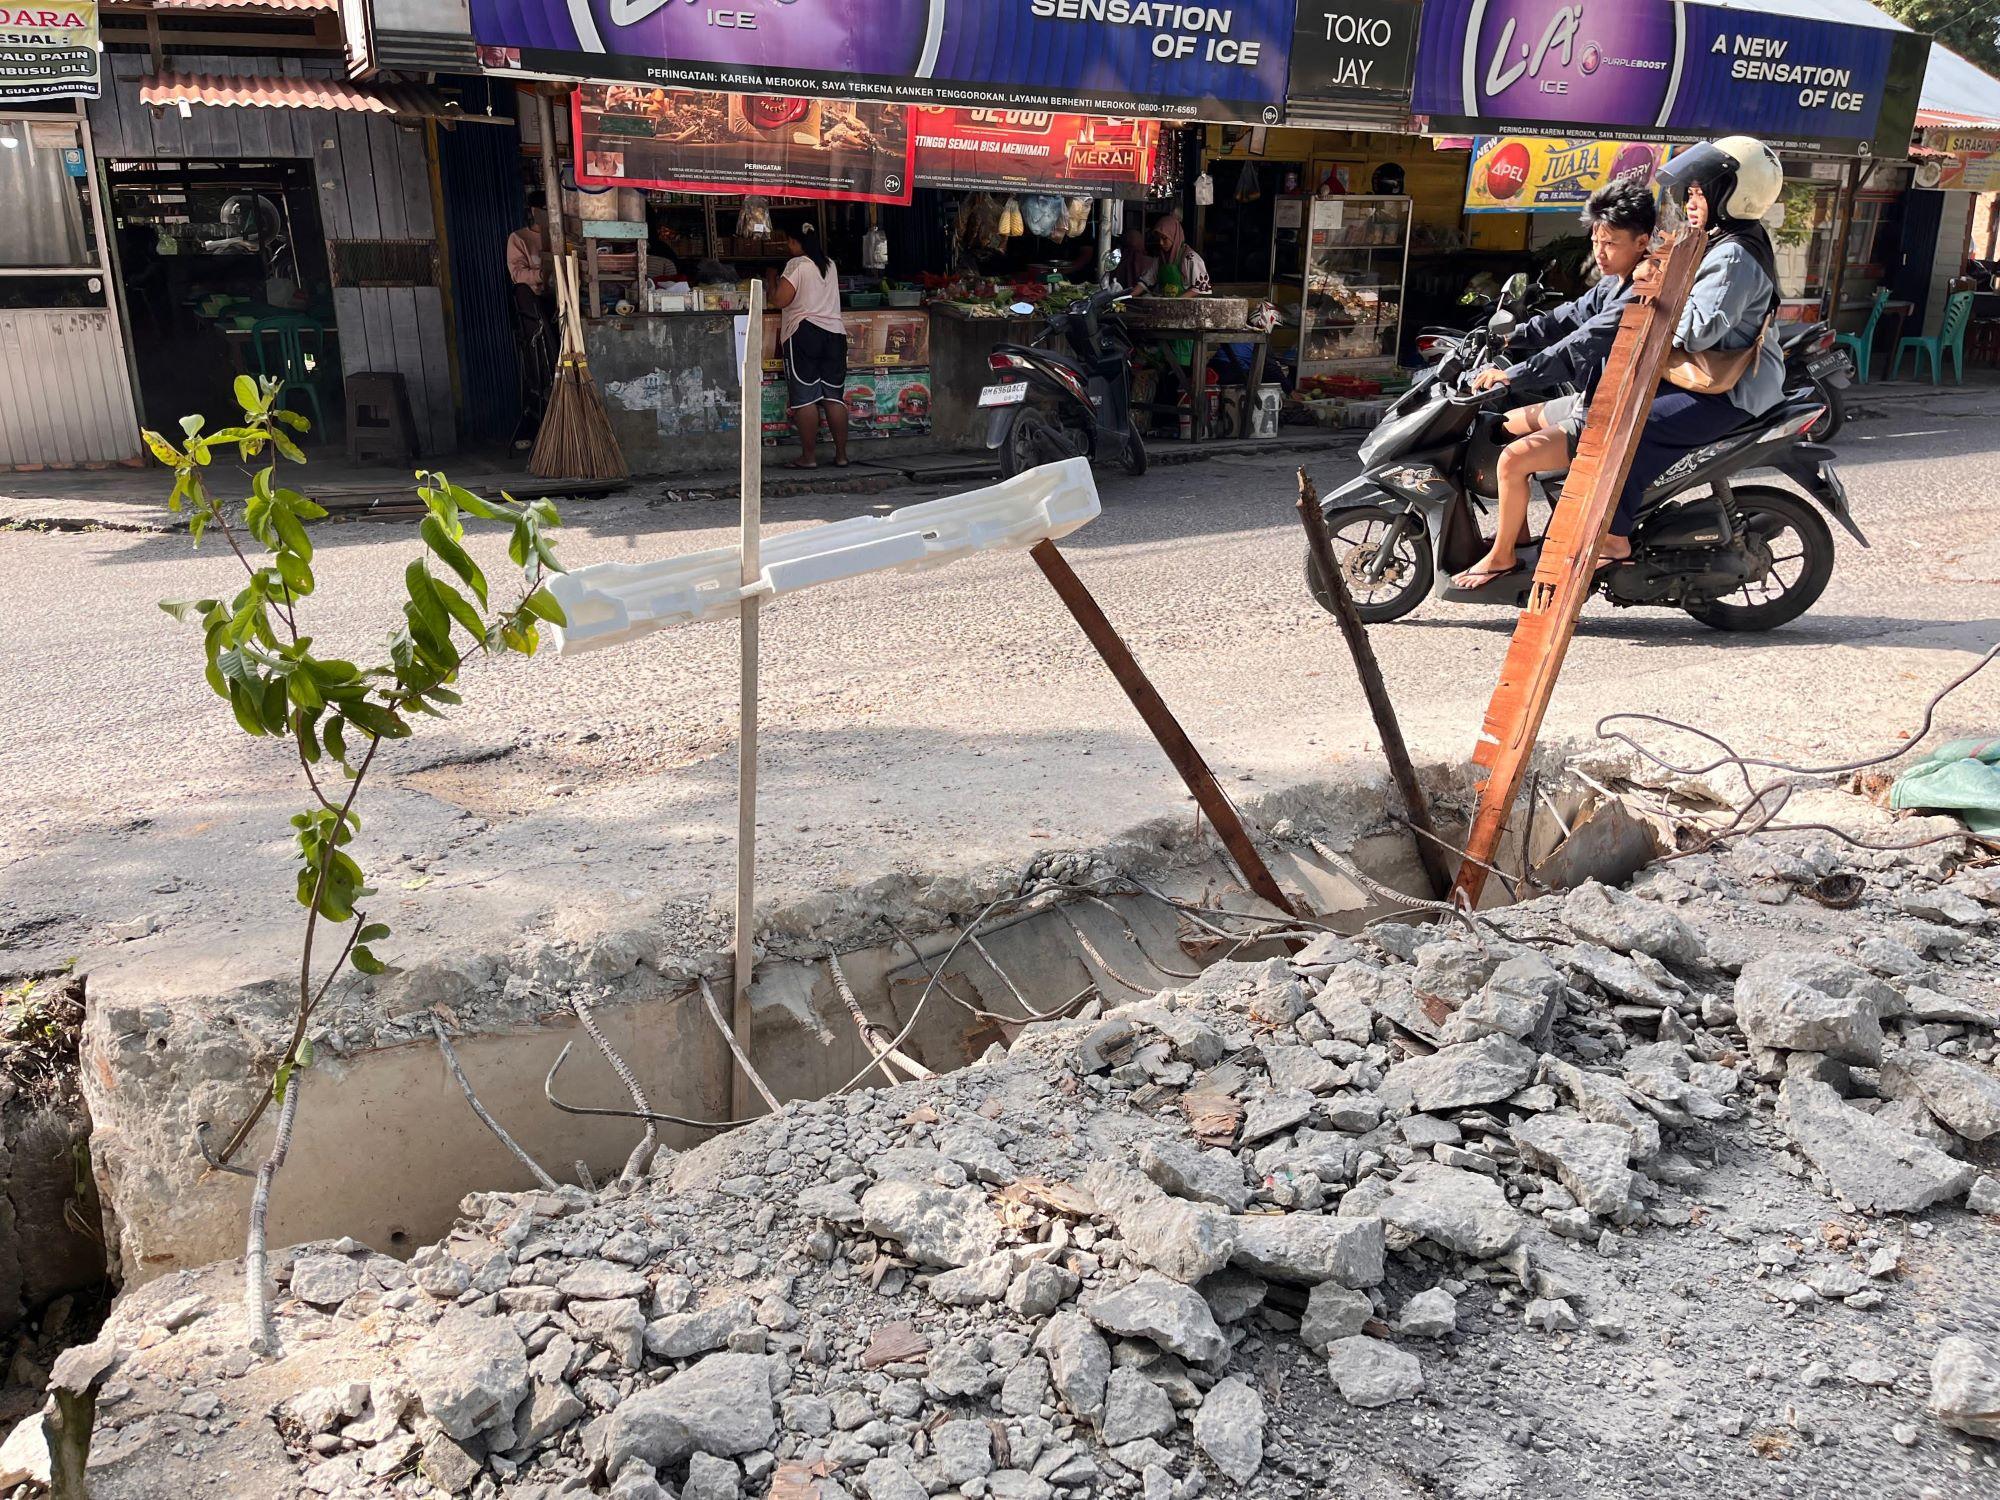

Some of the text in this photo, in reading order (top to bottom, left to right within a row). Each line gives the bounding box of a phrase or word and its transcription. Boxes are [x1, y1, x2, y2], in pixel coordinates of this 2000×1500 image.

[706, 9, 758, 29] ICE
[1323, 12, 1392, 47] TOKO
[0, 51, 89, 62] ALO PATIN
[1152, 34, 1261, 65] OF ICE
[1711, 34, 1788, 59] A NEW
[61, 64, 90, 73] DLL
[1332, 57, 1374, 86] JAY
[1731, 59, 1851, 88] SENSATION
[43, 84, 96, 93] KAMBING
[647, 68, 1198, 115] PERINGATAN: KARENA MEROKOK, SAYA TERKENA KANKER TENGGOROKAN. LAYANAN BERHENTI MEROKOK (0800-177-6565)
[1539, 80, 1569, 94] ICE
[1798, 88, 1864, 112] OF ICE
[1498, 126, 1539, 135] PERINGATAN:
[1540, 128, 1565, 136] KARENA
[1566, 129, 1597, 138] MEROKOK,
[1599, 131, 1613, 139] SAYA
[1615, 132, 1641, 140] TERKENA
[948, 138, 979, 151] SEMUA
[980, 141, 1000, 153] BISA
[1001, 143, 1050, 157] MENIKMATI
[1476, 137, 1498, 159] NEW
[1952, 138, 1991, 152] SARAPAN
[1073, 150, 1133, 166] MERAH
[1541, 146, 1599, 182] JUARA
[1491, 162, 1524, 183] APEL
[1379, 465, 1405, 479] HONDA
